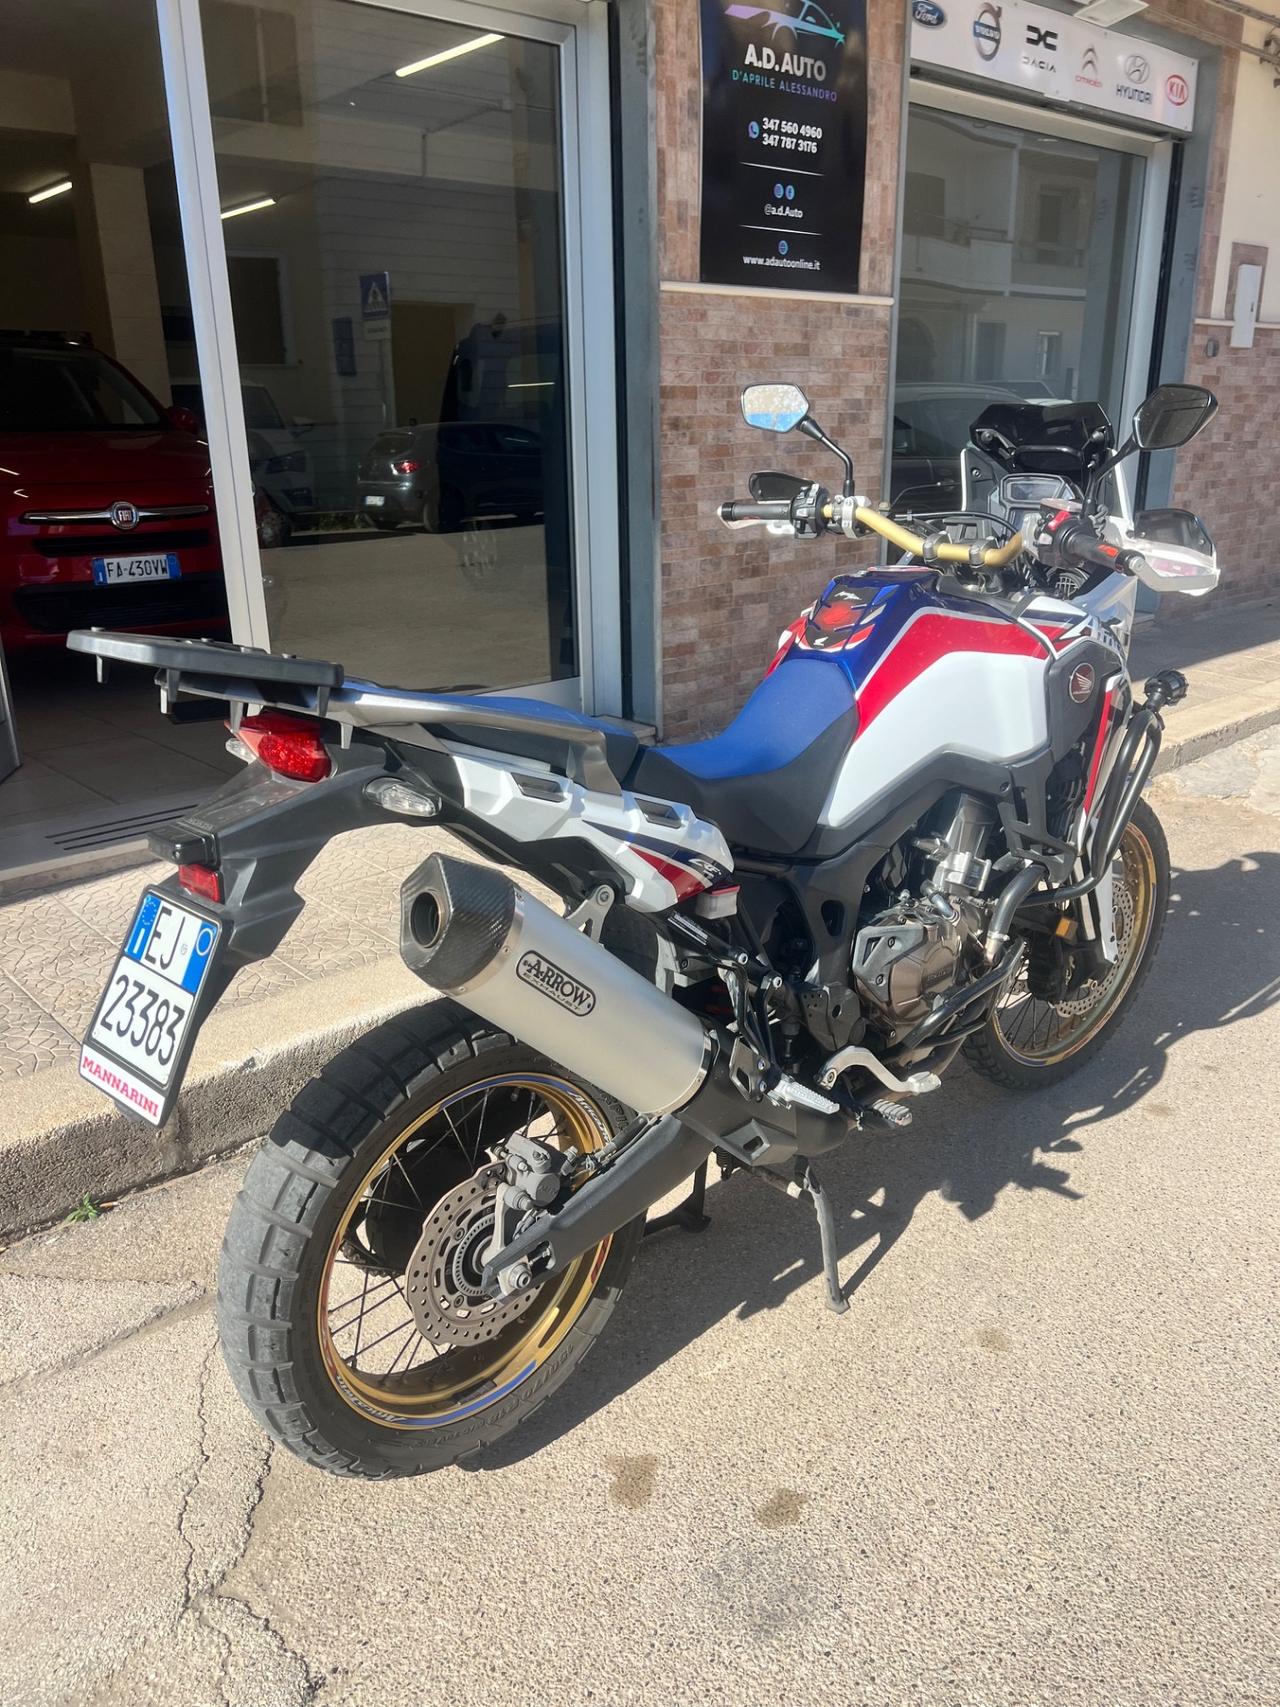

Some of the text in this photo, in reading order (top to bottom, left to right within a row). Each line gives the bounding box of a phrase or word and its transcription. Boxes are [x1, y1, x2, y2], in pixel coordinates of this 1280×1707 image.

[914, 2, 940, 24] Ford
[1022, 56, 1057, 73] DACIA
[732, 69, 838, 102] D'APRILE ALESSANDRO
[1168, 80, 1187, 101] KIA
[762, 117, 823, 139] 347 560 4960
[762, 134, 818, 154] 347 787 3176
[742, 256, 821, 271] www.adautoonline.it
[144, 906, 186, 970] EJ
[526, 958, 591, 1007] ARROW
[100, 974, 186, 1066] 23383
[81, 1055, 159, 1118] MANNARINI
